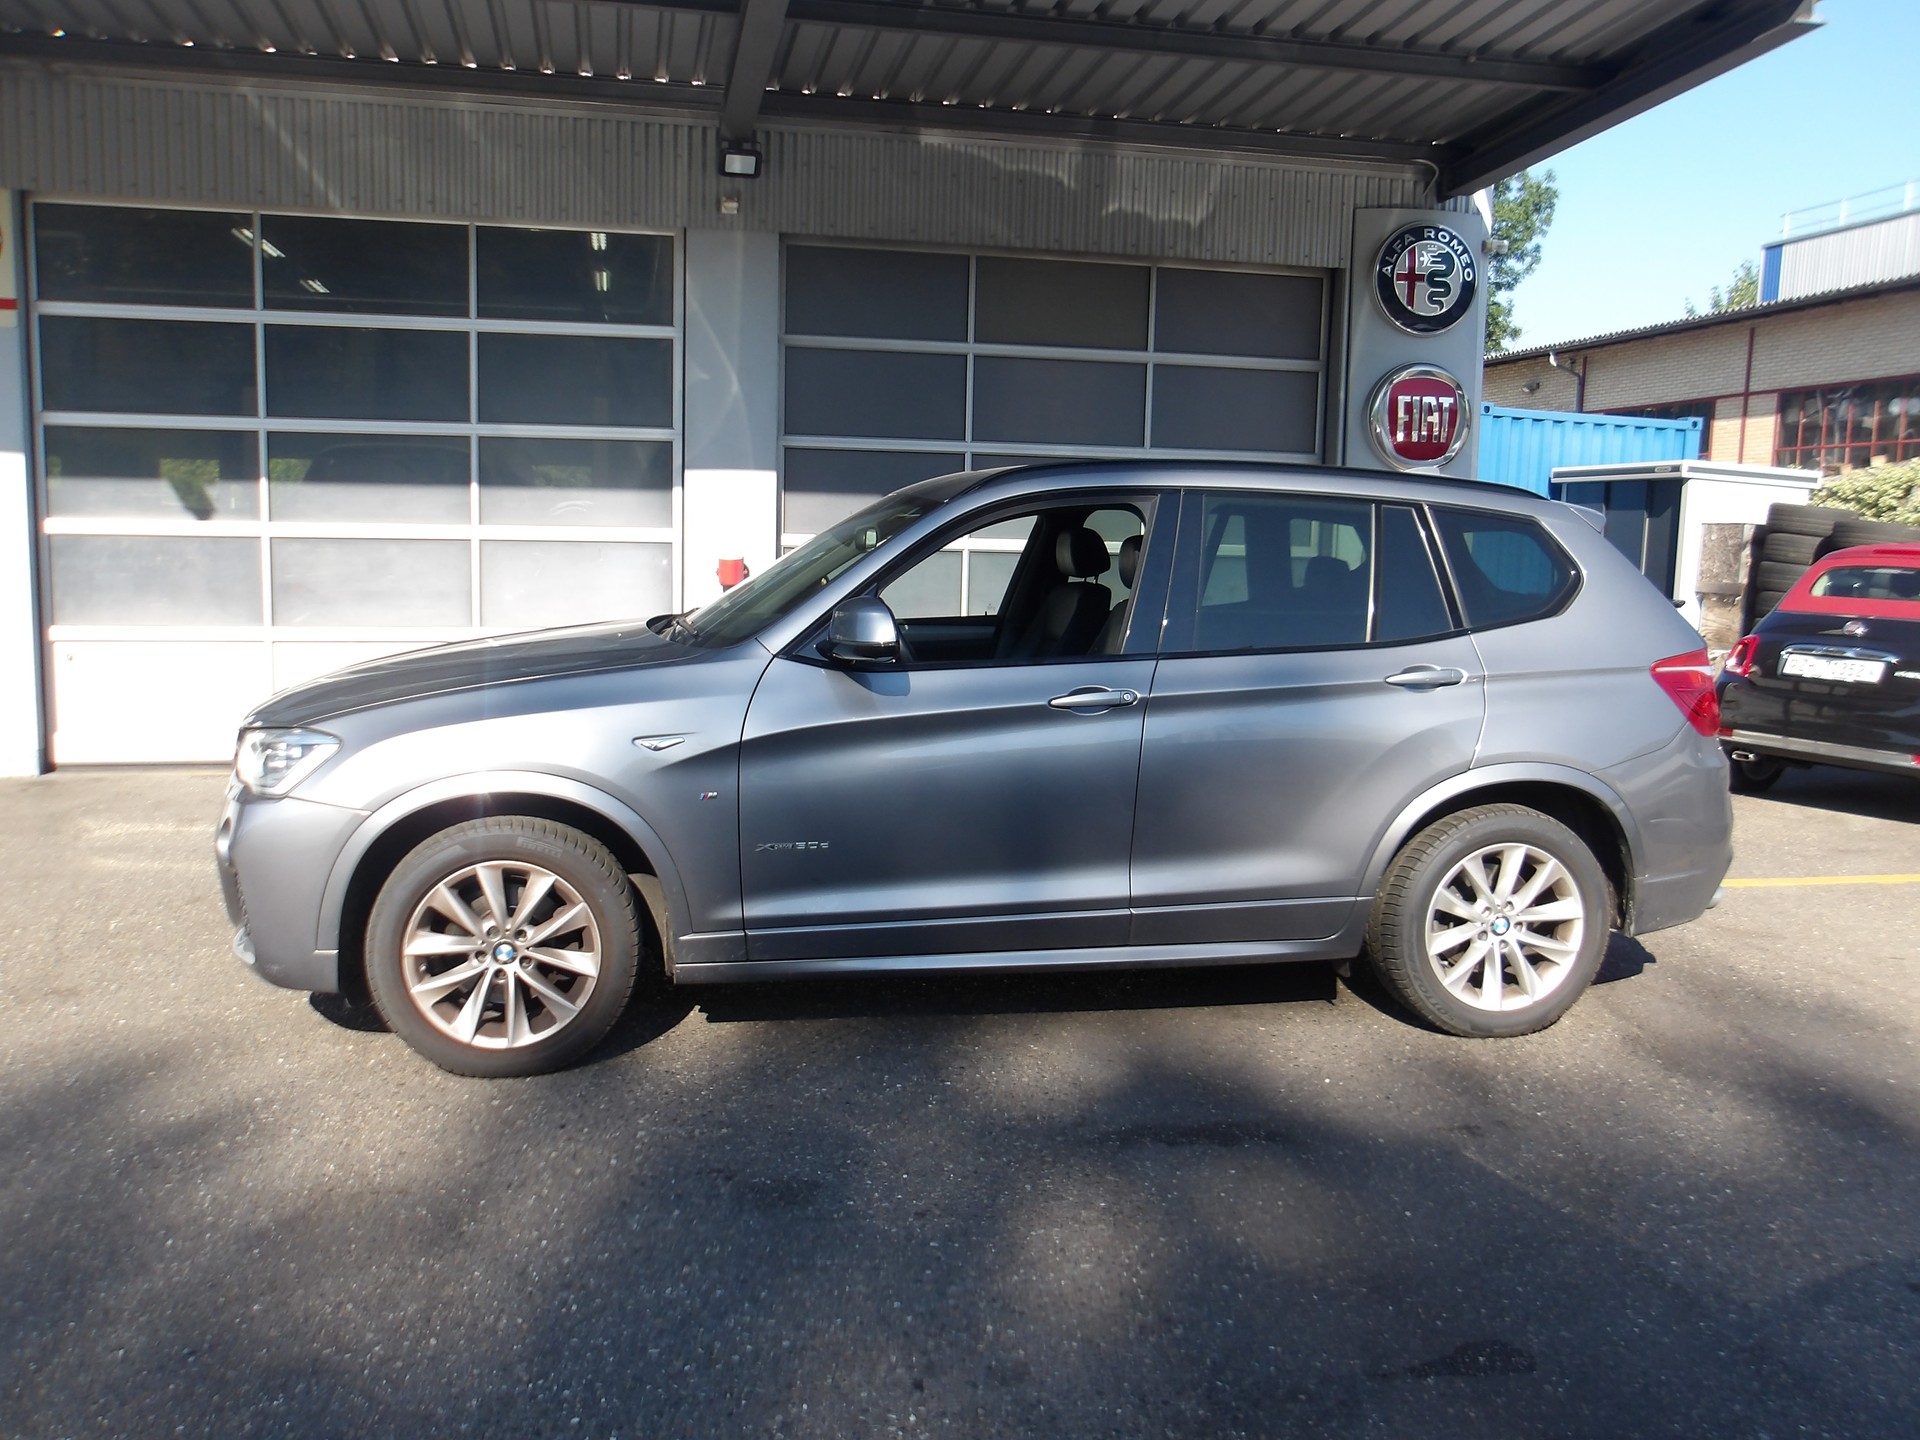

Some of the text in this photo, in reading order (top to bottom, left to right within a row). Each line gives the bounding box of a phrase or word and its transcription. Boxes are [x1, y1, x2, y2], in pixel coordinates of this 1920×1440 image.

[1381, 228, 1474, 282] ALFA ROMEO
[1396, 395, 1454, 443] FIAT
